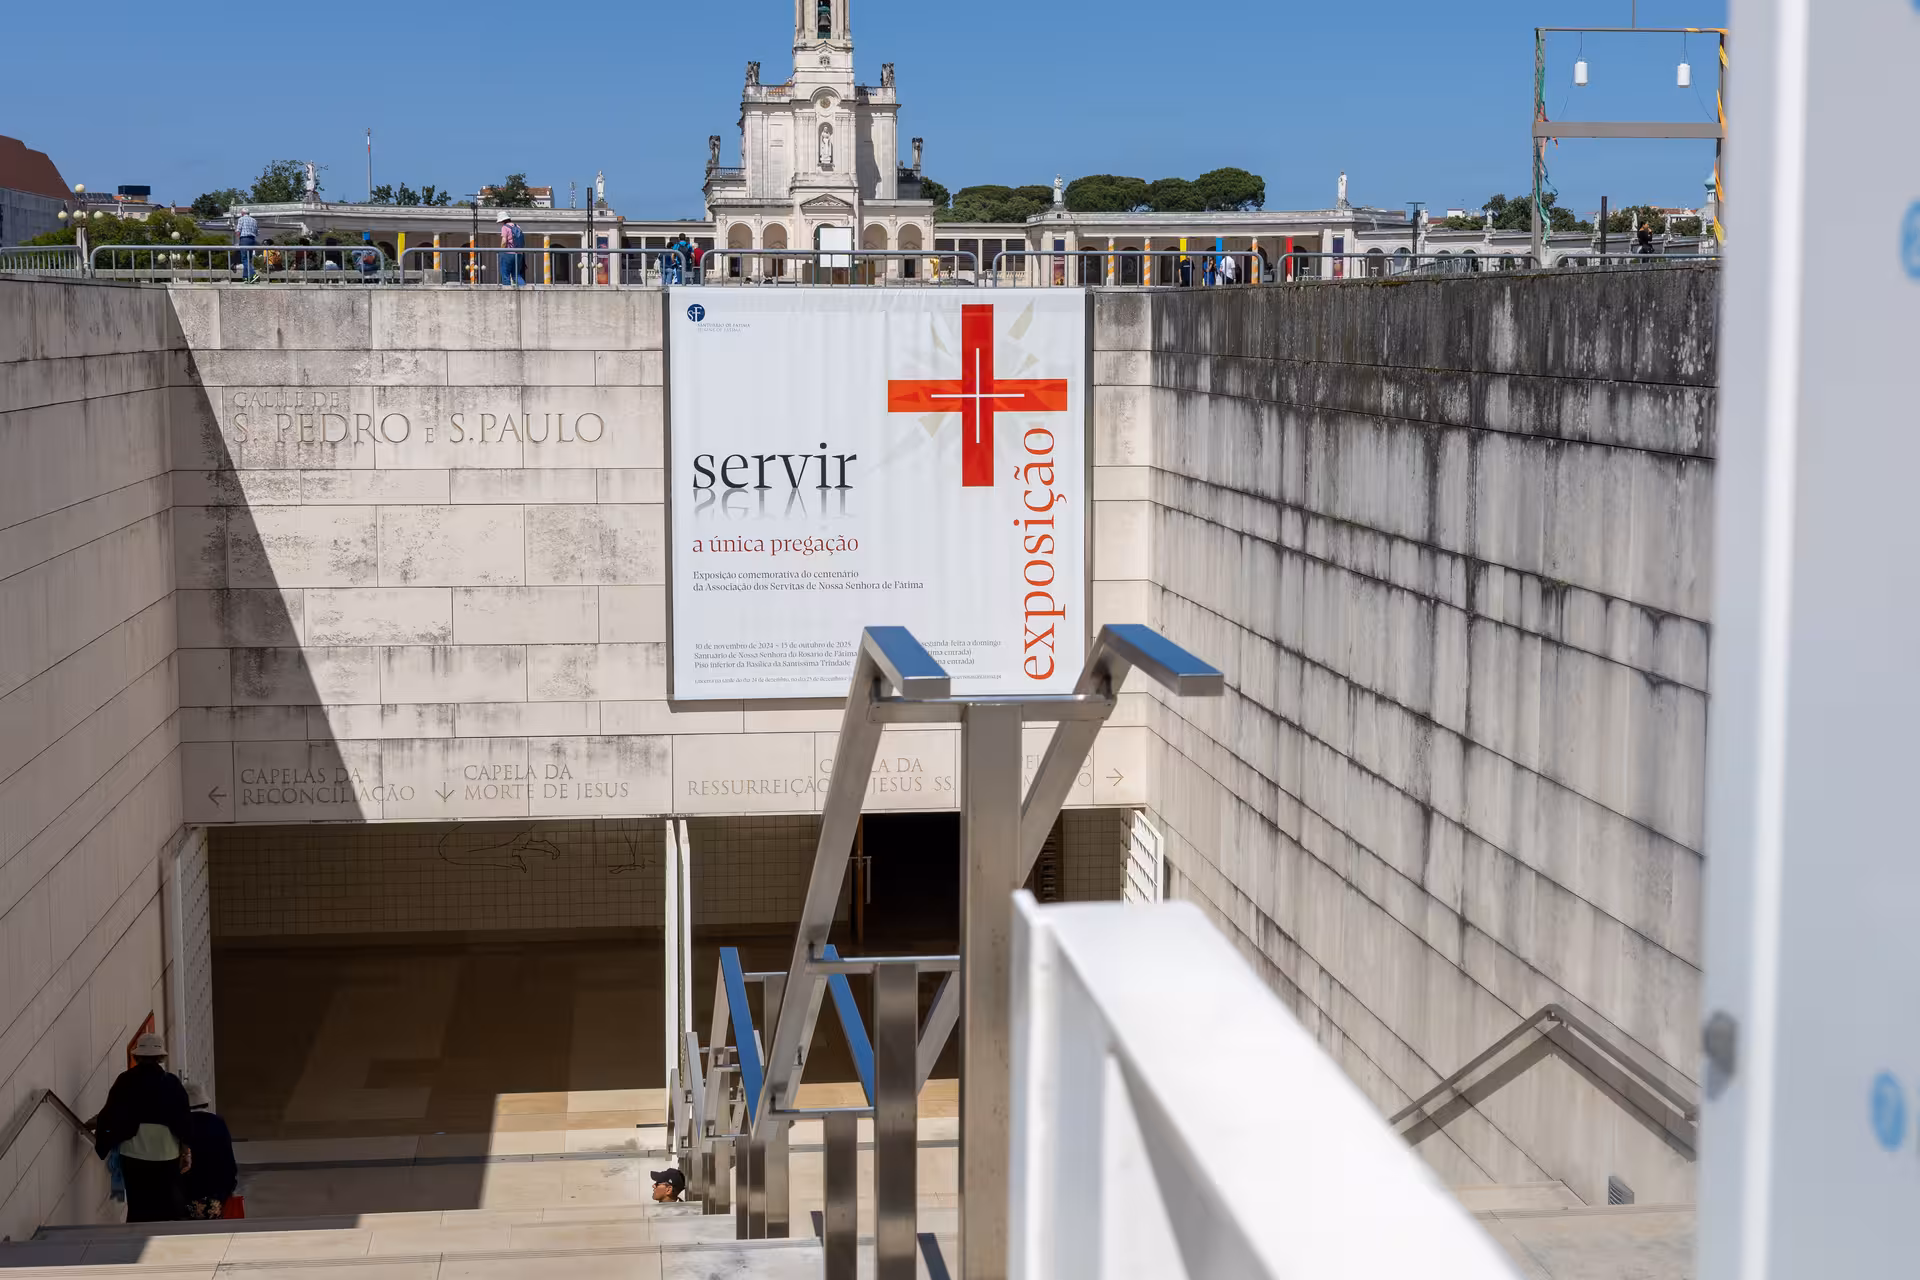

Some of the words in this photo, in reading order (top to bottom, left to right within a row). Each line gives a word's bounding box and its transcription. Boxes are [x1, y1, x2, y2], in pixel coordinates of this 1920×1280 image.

[312, 391, 340, 408] DE
[275, 412, 411, 445] PEDRO
[692, 442, 857, 489] servir
[692, 539, 704, 552] a
[709, 535, 765, 552] única
[769, 534, 859, 556] pregação
[1013, 427, 1067, 681] exposição
[692, 570, 737, 581] Exposição
[738, 570, 800, 580] comemorativa
[801, 570, 812, 579] do
[813, 569, 859, 578] centenário
[692, 582, 704, 592] da
[705, 581, 752, 593] Associação
[753, 581, 769, 591] dos
[770, 581, 805, 591] Servitas
[806, 581, 817, 590] de
[818, 581, 844, 590] Nossa
[845, 581, 880, 590] Senhora
[881, 580, 892, 590] de
[894, 580, 924, 589] Fátima
[713, 642, 748, 650] novembro
[463, 764, 537, 781] CAPELA
[545, 763, 573, 780] DA
[896, 757, 924, 773] DA
[241, 767, 326, 785] CAPELAS
[334, 767, 364, 784] DA
[242, 783, 415, 806] RECONCILIAÇÃO
[464, 784, 535, 801] MORTE
[543, 783, 568, 799] DE
[577, 782, 629, 800] JESUS
[687, 776, 830, 798] RESSURREIÇÃO
[872, 776, 922, 794] JESUS
